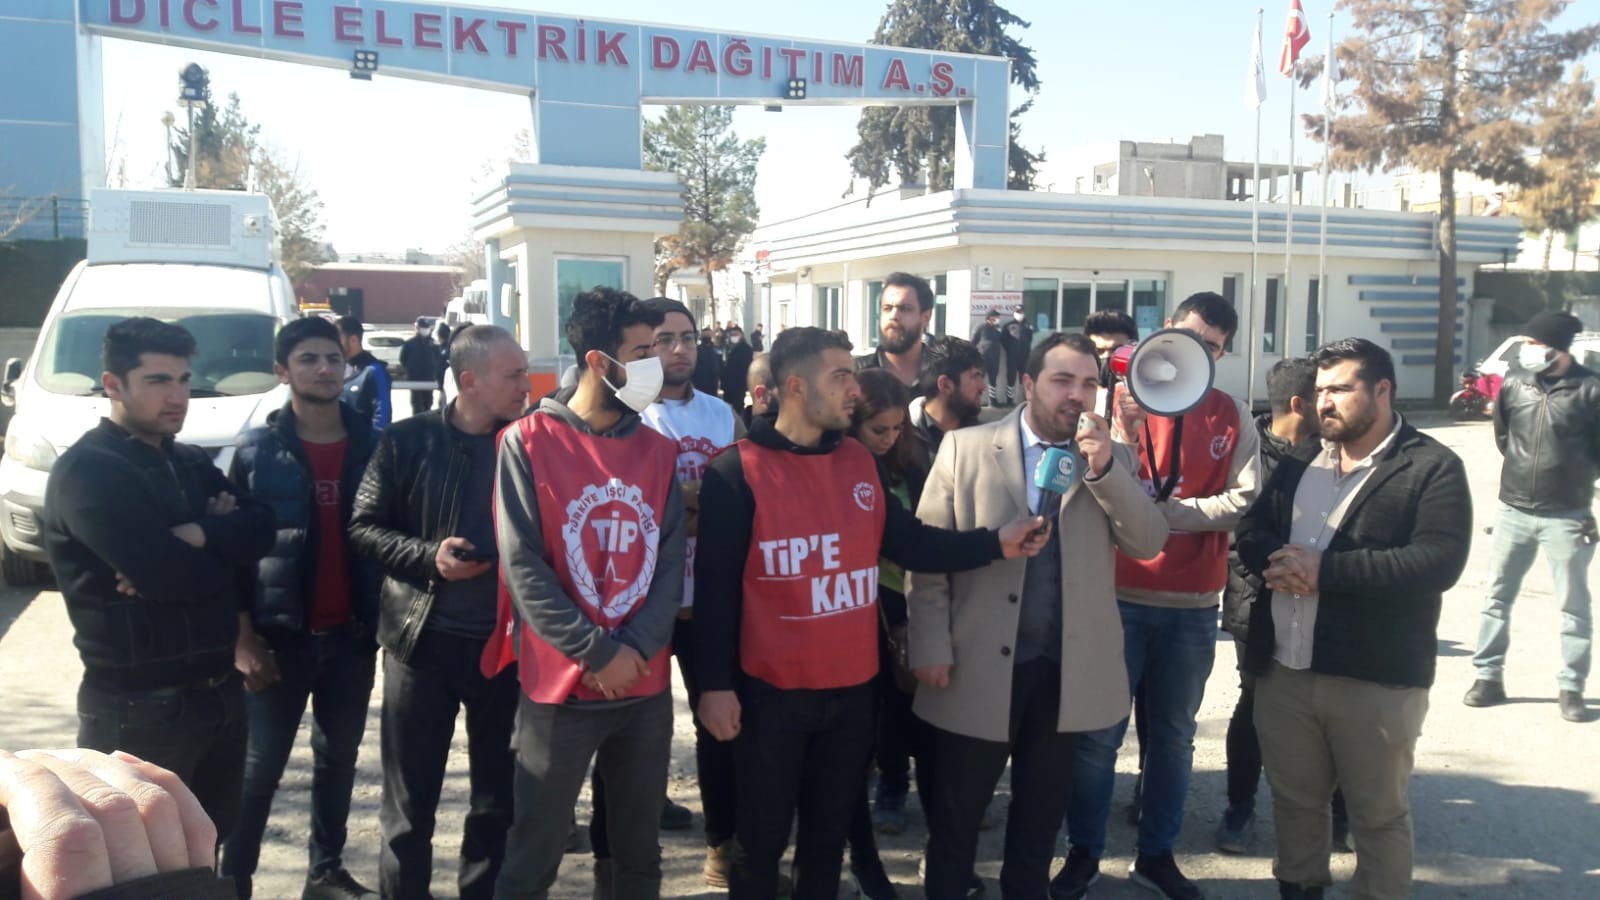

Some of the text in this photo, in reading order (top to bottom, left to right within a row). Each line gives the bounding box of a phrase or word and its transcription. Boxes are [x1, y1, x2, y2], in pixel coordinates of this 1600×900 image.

[334, 5, 630, 66] ELEKTRİK
[652, 37, 865, 87] DAĞITIM
[884, 58, 968, 97] A.Ş.
[569, 486, 657, 534] TÜRKİYE İŞÇİ PATİSİ
[591, 511, 638, 553] TİP
